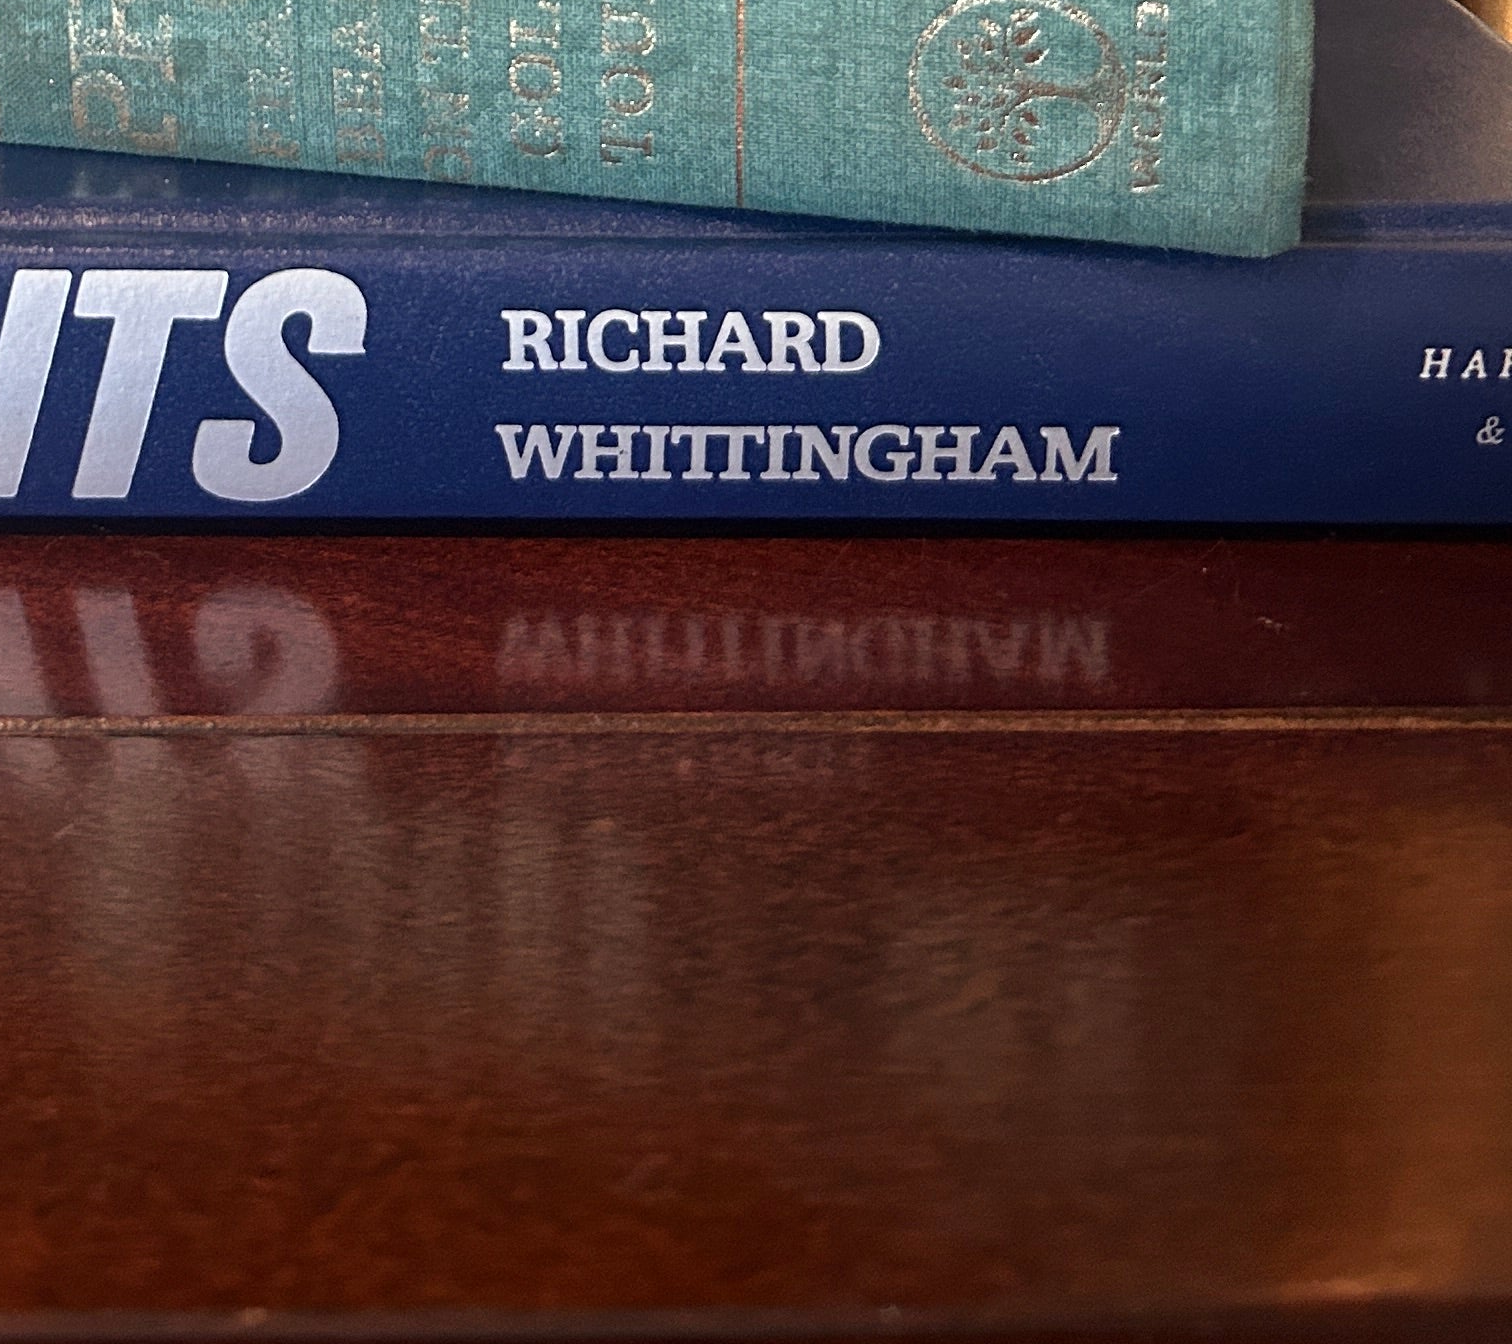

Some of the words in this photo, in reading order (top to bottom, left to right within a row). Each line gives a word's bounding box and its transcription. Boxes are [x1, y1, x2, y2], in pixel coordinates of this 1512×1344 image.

[500, 309, 881, 373] RICHARD
[494, 424, 1120, 482] WHITTINGHAM
[1475, 415, 1506, 445] &
